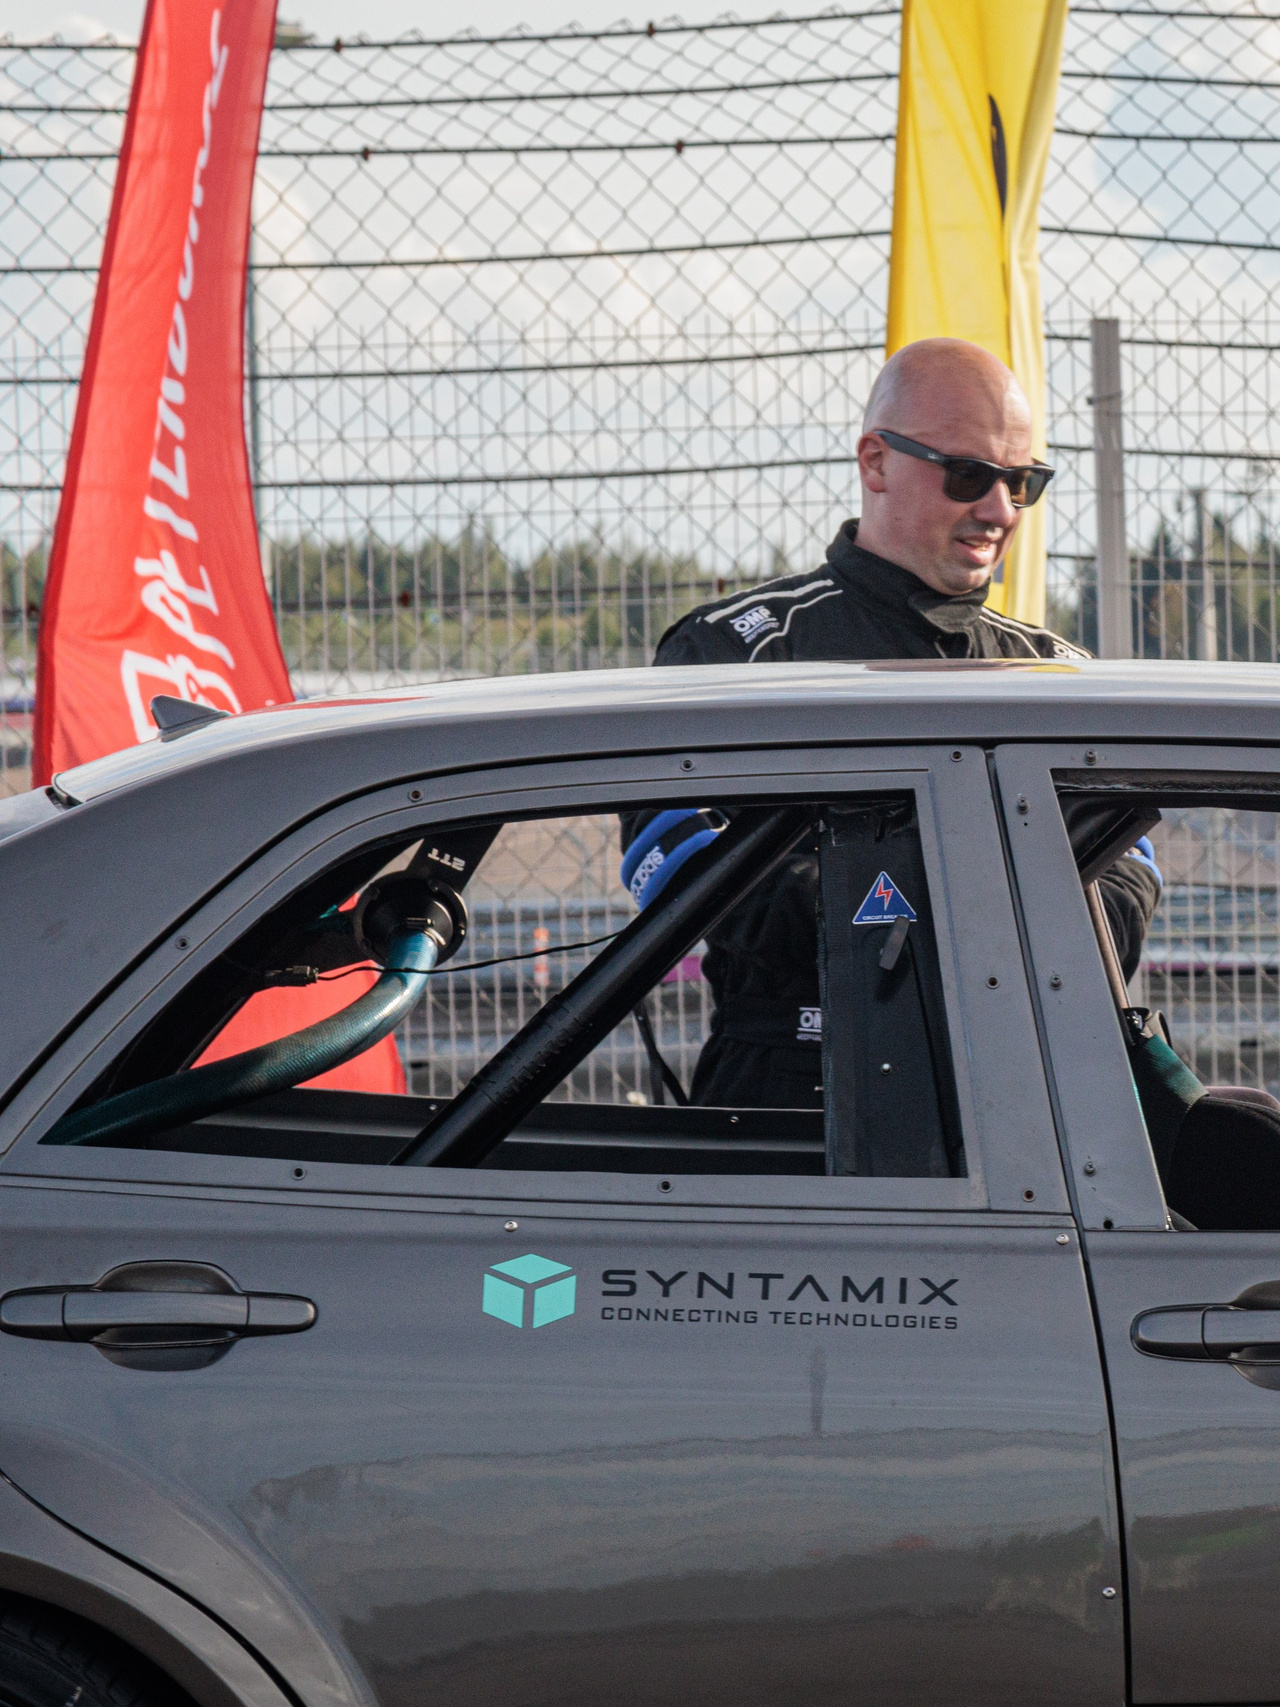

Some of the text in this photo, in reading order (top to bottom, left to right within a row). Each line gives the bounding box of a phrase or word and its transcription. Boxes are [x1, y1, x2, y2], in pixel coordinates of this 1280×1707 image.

[733, 607, 771, 632] OMP
[800, 1011, 822, 1029] OM
[601, 1269, 960, 1307] SYNTAMIX
[601, 1306, 959, 1330] CONNECTING TECHNOLOGIES
